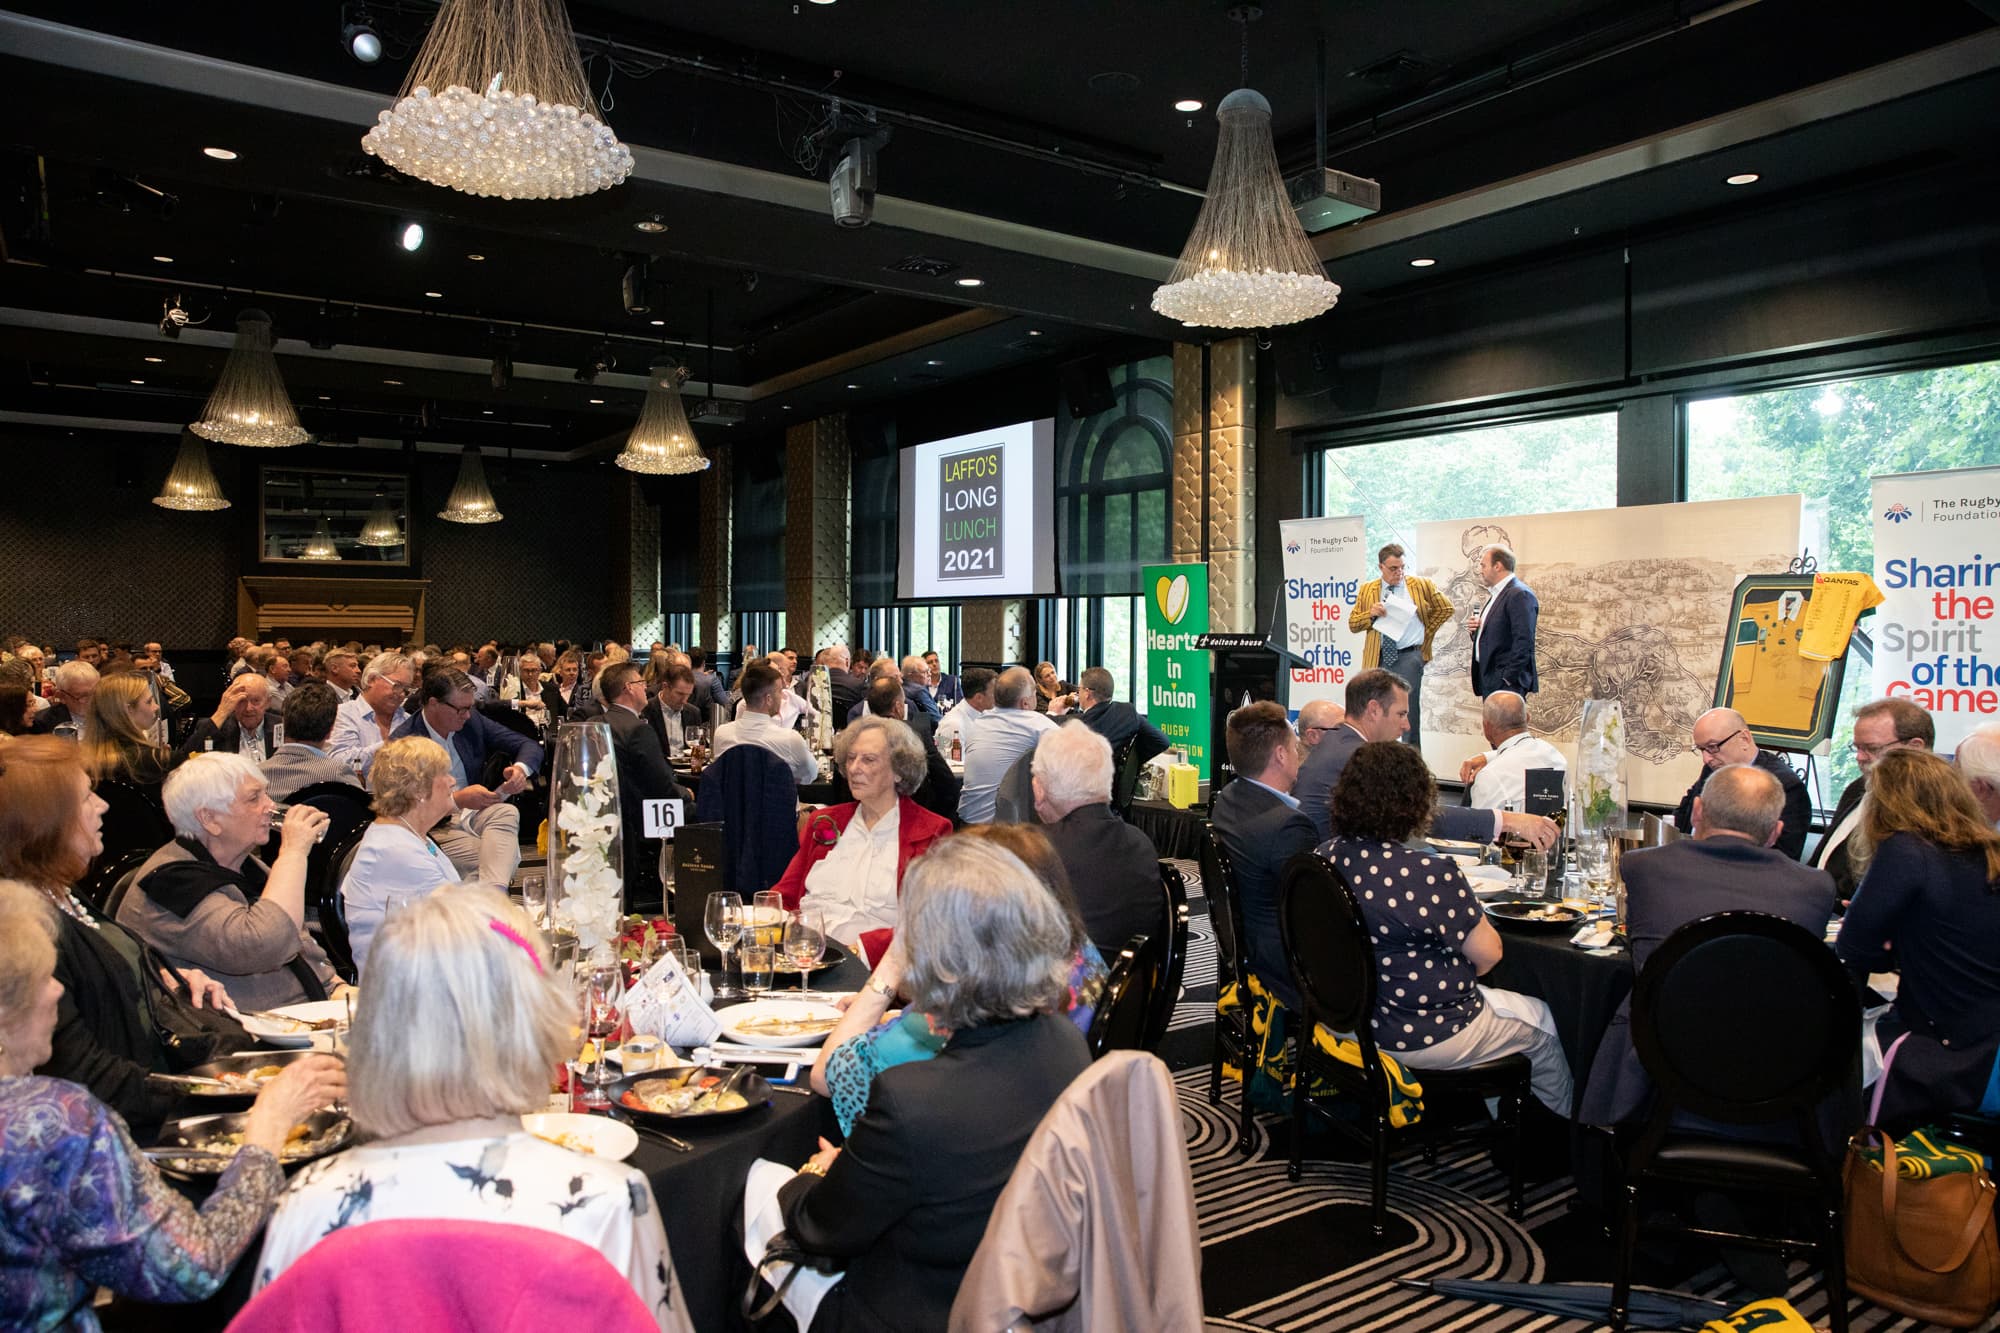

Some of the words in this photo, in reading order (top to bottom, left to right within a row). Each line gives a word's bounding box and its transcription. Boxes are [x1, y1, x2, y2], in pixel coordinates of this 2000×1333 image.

[945, 455, 997, 482] LAFFO'S
[945, 486, 997, 512] LONG
[1933, 499, 1956, 509] The
[1960, 496, 2000, 509] Rugby
[1933, 509, 2000, 522] Foundatio
[945, 517, 997, 542] LUNCH
[1310, 537, 1321, 545] The
[1322, 537, 1342, 546] Rugby
[944, 547, 995, 572] 2021
[1885, 554, 2000, 589] Sharin
[1288, 576, 1358, 605] Sharing
[1823, 577, 1860, 586] QANTAS
[1311, 599, 1340, 621] the
[1932, 588, 1994, 620] the
[1147, 629, 1200, 651] Hearts
[1239, 638, 1263, 647] house
[1289, 621, 1336, 649] Spirit
[1882, 620, 1982, 662] Spirit
[1303, 644, 1322, 665] of
[1323, 644, 1351, 667] the
[1167, 657, 1182, 679] in
[1291, 667, 1344, 684] Game
[1911, 654, 1949, 686] of
[1953, 655, 2000, 687] th
[1152, 683, 1196, 709] Union
[1161, 723, 1190, 737] RUGBY
[651, 803, 675, 827] 16
